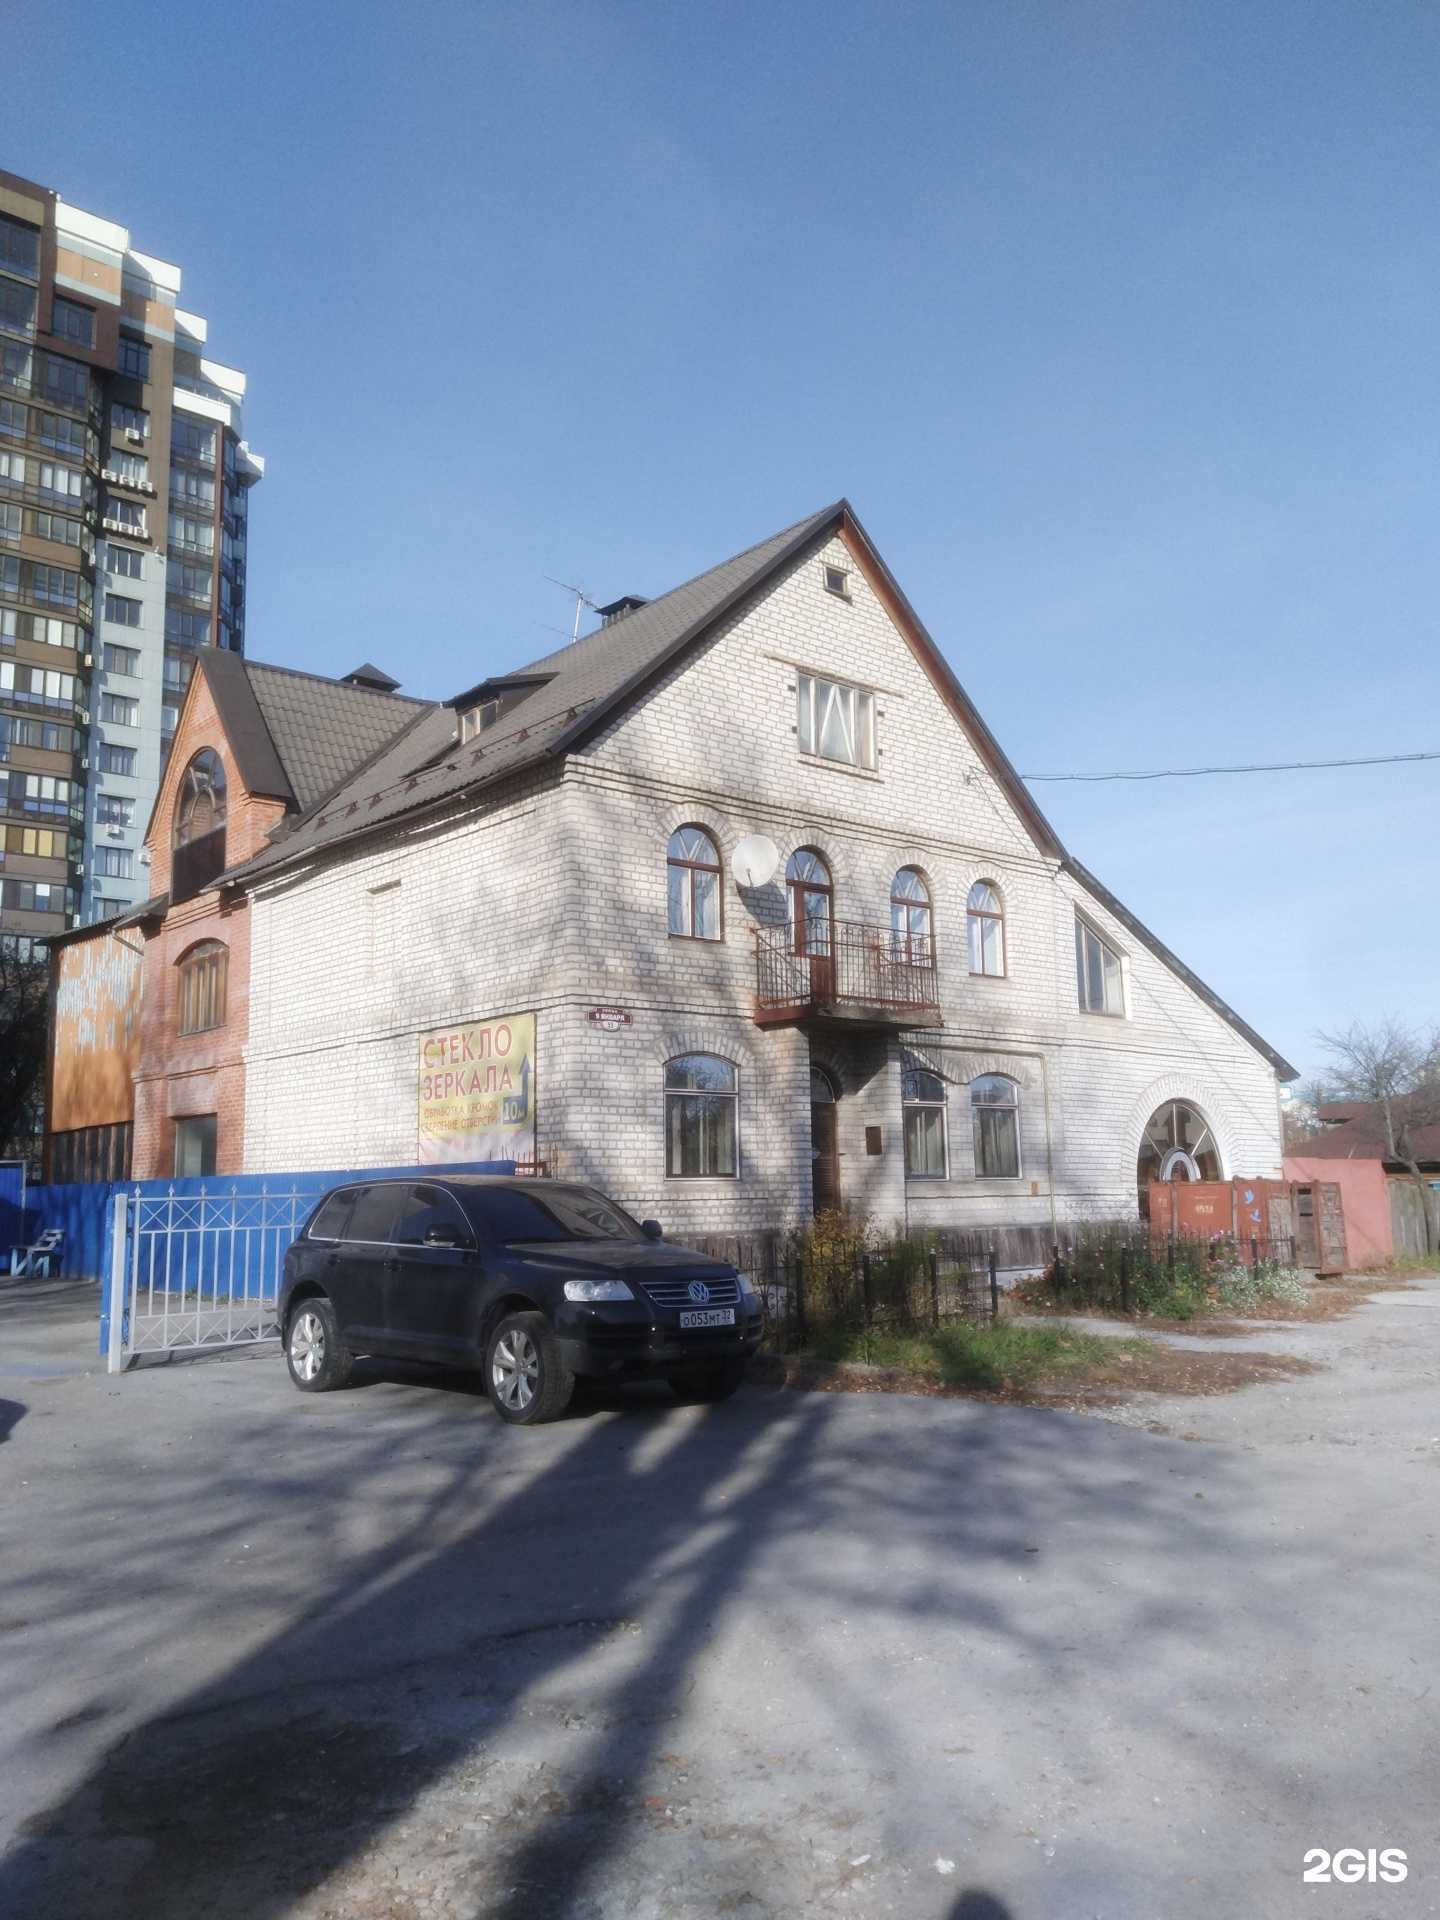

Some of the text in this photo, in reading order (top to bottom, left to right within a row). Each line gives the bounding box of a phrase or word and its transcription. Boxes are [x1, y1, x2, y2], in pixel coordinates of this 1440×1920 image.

[600, 1013, 625, 1021] ЯНВАРЯ
[423, 1024, 512, 1068] СТЕКЛО
[423, 1064, 512, 1101] ЗЕРКАЛА
